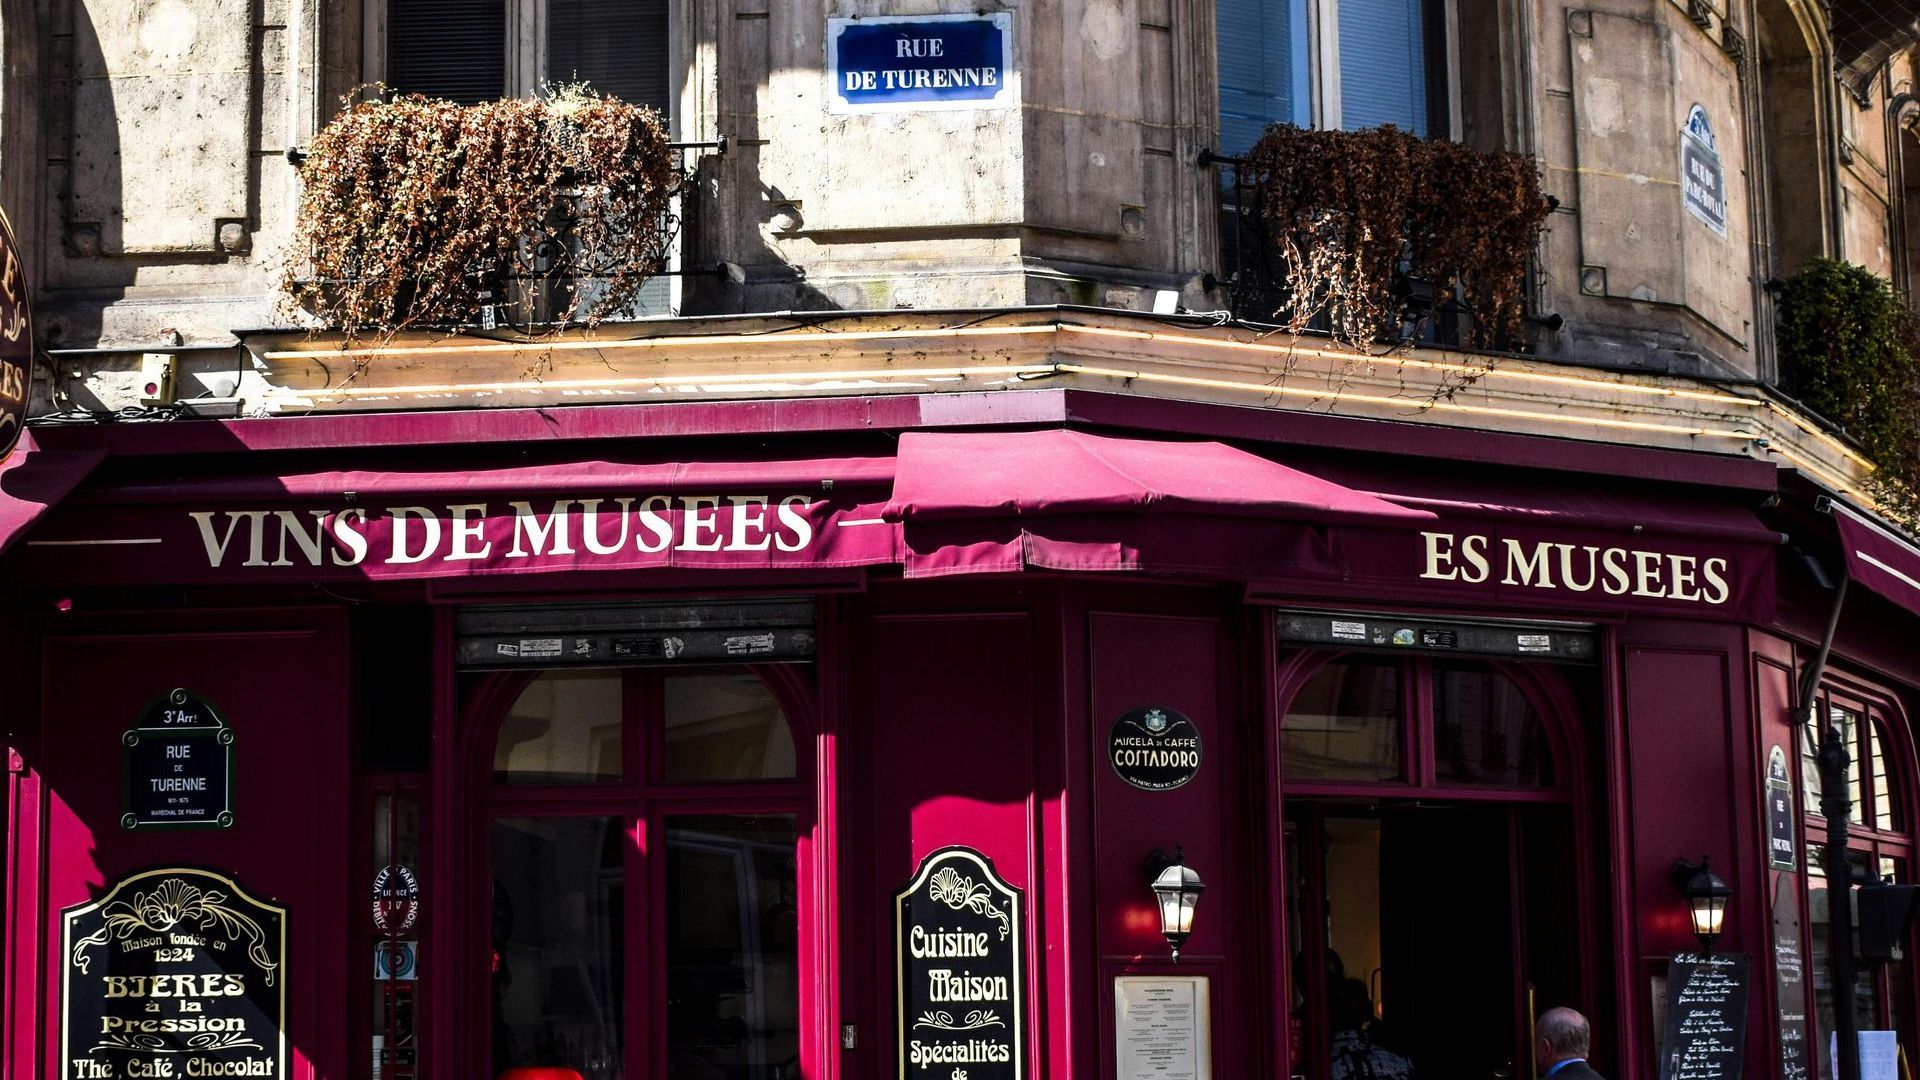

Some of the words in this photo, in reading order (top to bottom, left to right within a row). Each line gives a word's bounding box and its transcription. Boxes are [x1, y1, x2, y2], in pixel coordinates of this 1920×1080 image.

[896, 38, 944, 58] RUE
[846, 70, 877, 91] DE
[882, 66, 998, 90] TURENNE
[0, 358, 23, 401] ES
[188, 507, 368, 567] VINS
[384, 502, 492, 565] DE
[505, 495, 813, 559] MUSEES
[1419, 531, 1490, 584] ES
[1501, 538, 1730, 605] MUSEES
[166, 745, 190, 759] RUE
[1114, 737, 1154, 748] MISCELA
[173, 764, 183, 773] DE
[1115, 750, 1199, 768] COSTADORO
[150, 777, 207, 793] TURENNE
[185, 808, 205, 816] FRANCE
[373, 869, 391, 894] VILLE
[399, 868, 418, 894] PARIS
[120, 936, 163, 953] Maison
[170, 931, 206, 946] fondée
[214, 939, 227, 952] en
[910, 925, 989, 959] Cuisine
[153, 948, 195, 963] 1924
[928, 969, 1009, 1002] Maison
[145, 999, 161, 1013] à
[179, 999, 203, 1013] la
[100, 1014, 246, 1034] Pression
[910, 1039, 1010, 1069] Spécialités
[186, 1055, 274, 1077] Chocolat
[951, 1067, 968, 1080] de
